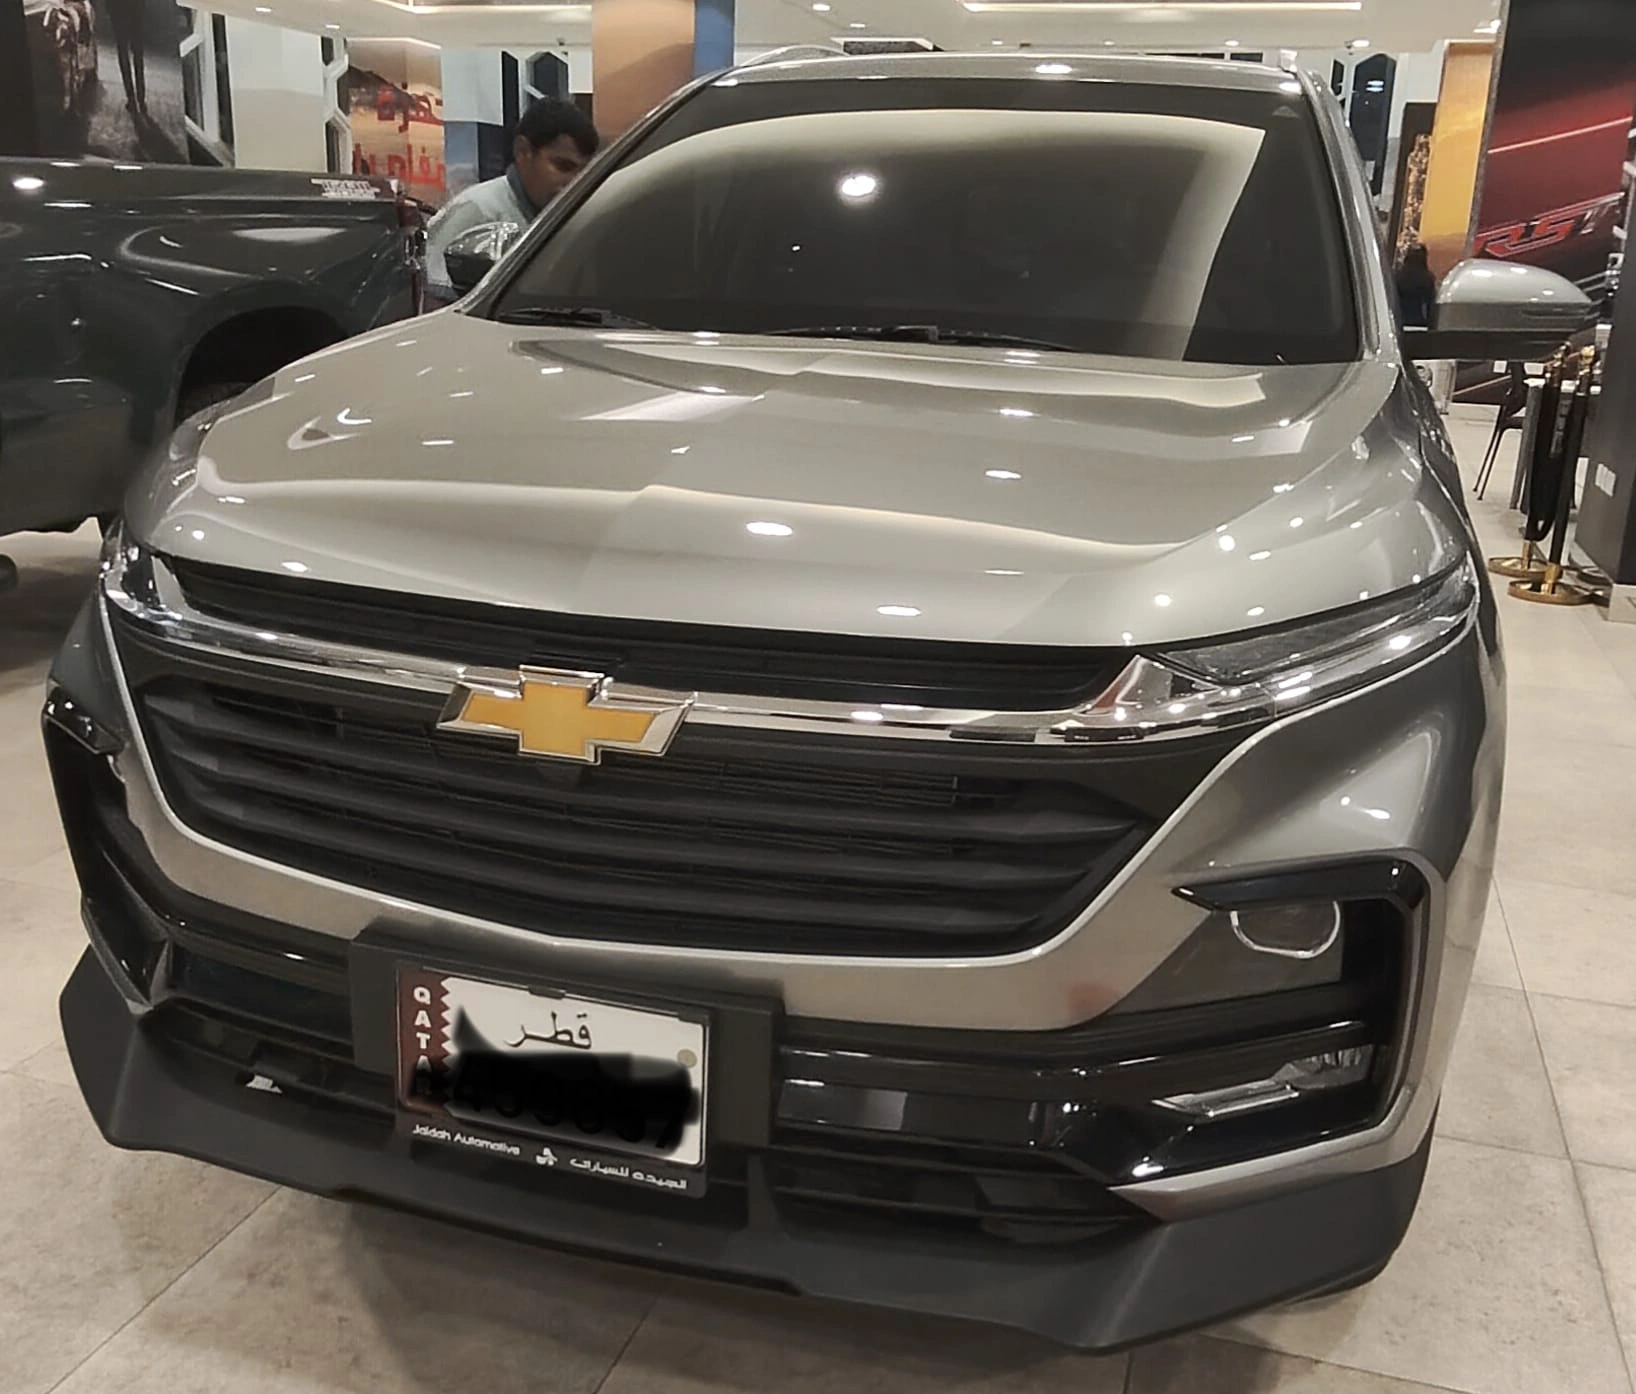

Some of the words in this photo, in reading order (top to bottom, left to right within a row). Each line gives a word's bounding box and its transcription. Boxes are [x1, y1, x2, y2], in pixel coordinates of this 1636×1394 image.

[412, 986, 433, 1088] QATA
[503, 1011, 593, 1050] قطر
[453, 1132, 520, 1156] Automotive
